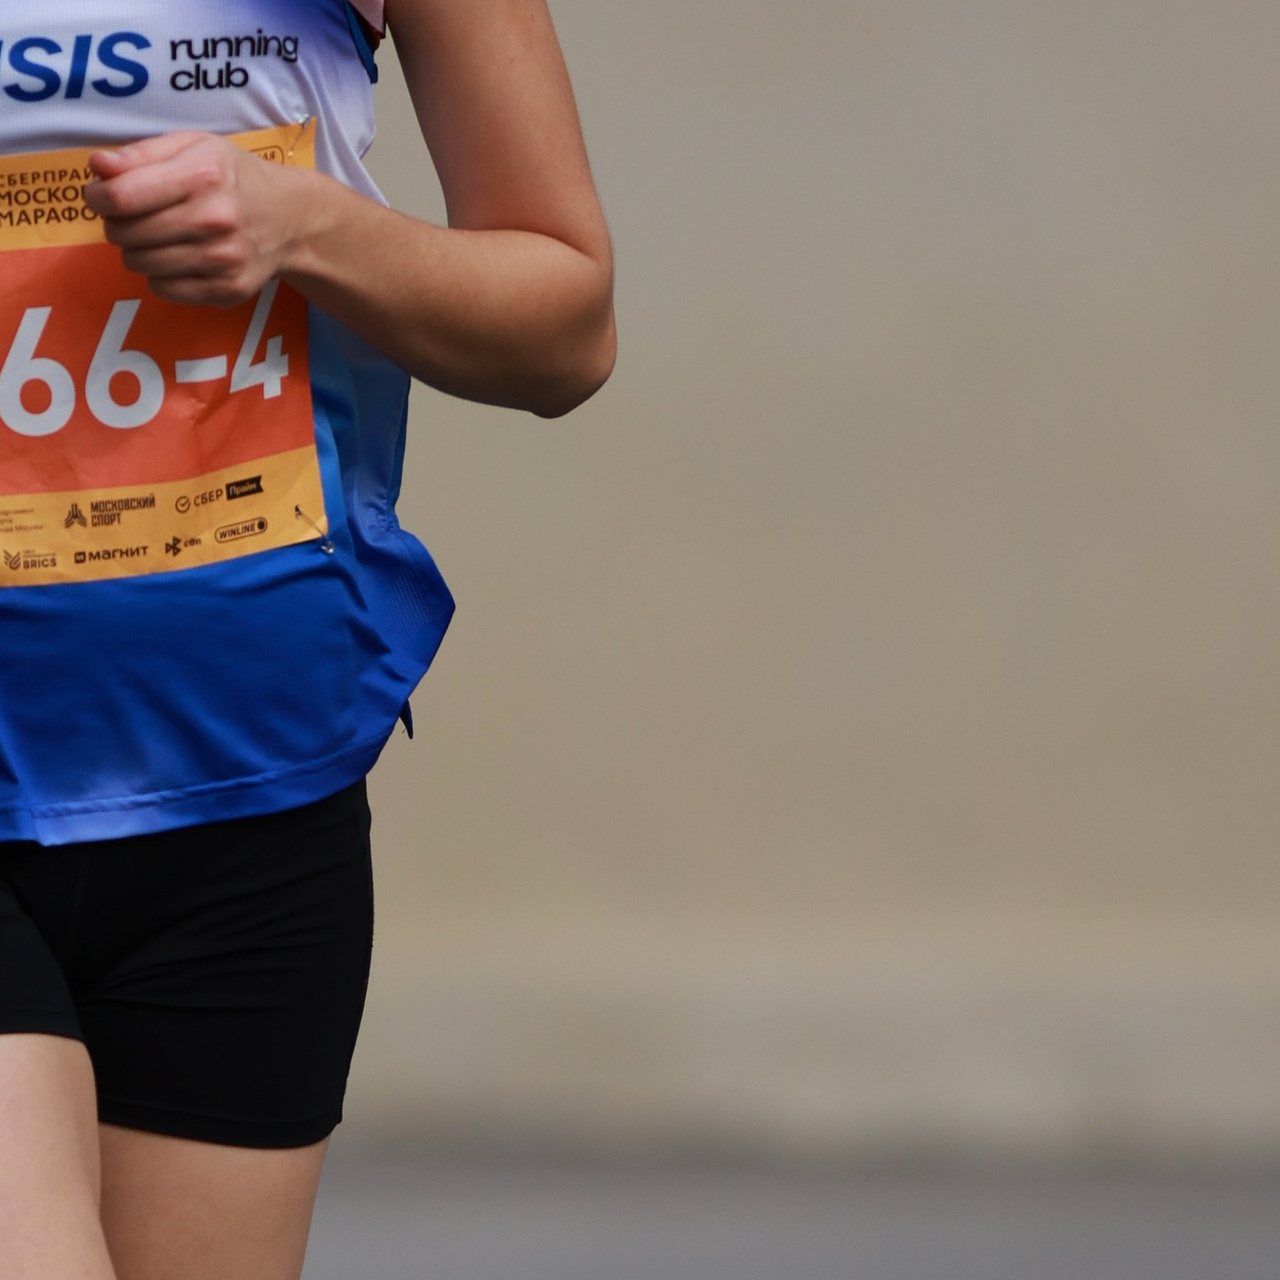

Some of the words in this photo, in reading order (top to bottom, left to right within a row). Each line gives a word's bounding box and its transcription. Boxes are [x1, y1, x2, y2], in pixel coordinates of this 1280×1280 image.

[170, 28, 299, 63] running
[170, 62, 250, 92] club
[90, 492, 156, 514] МОСКОВСКИЙ
[193, 488, 224, 508] СБЕР
[91, 512, 121, 527] СПОРТ
[219, 522, 256, 540] WINLINE
[23, 558, 57, 570] BRICS
